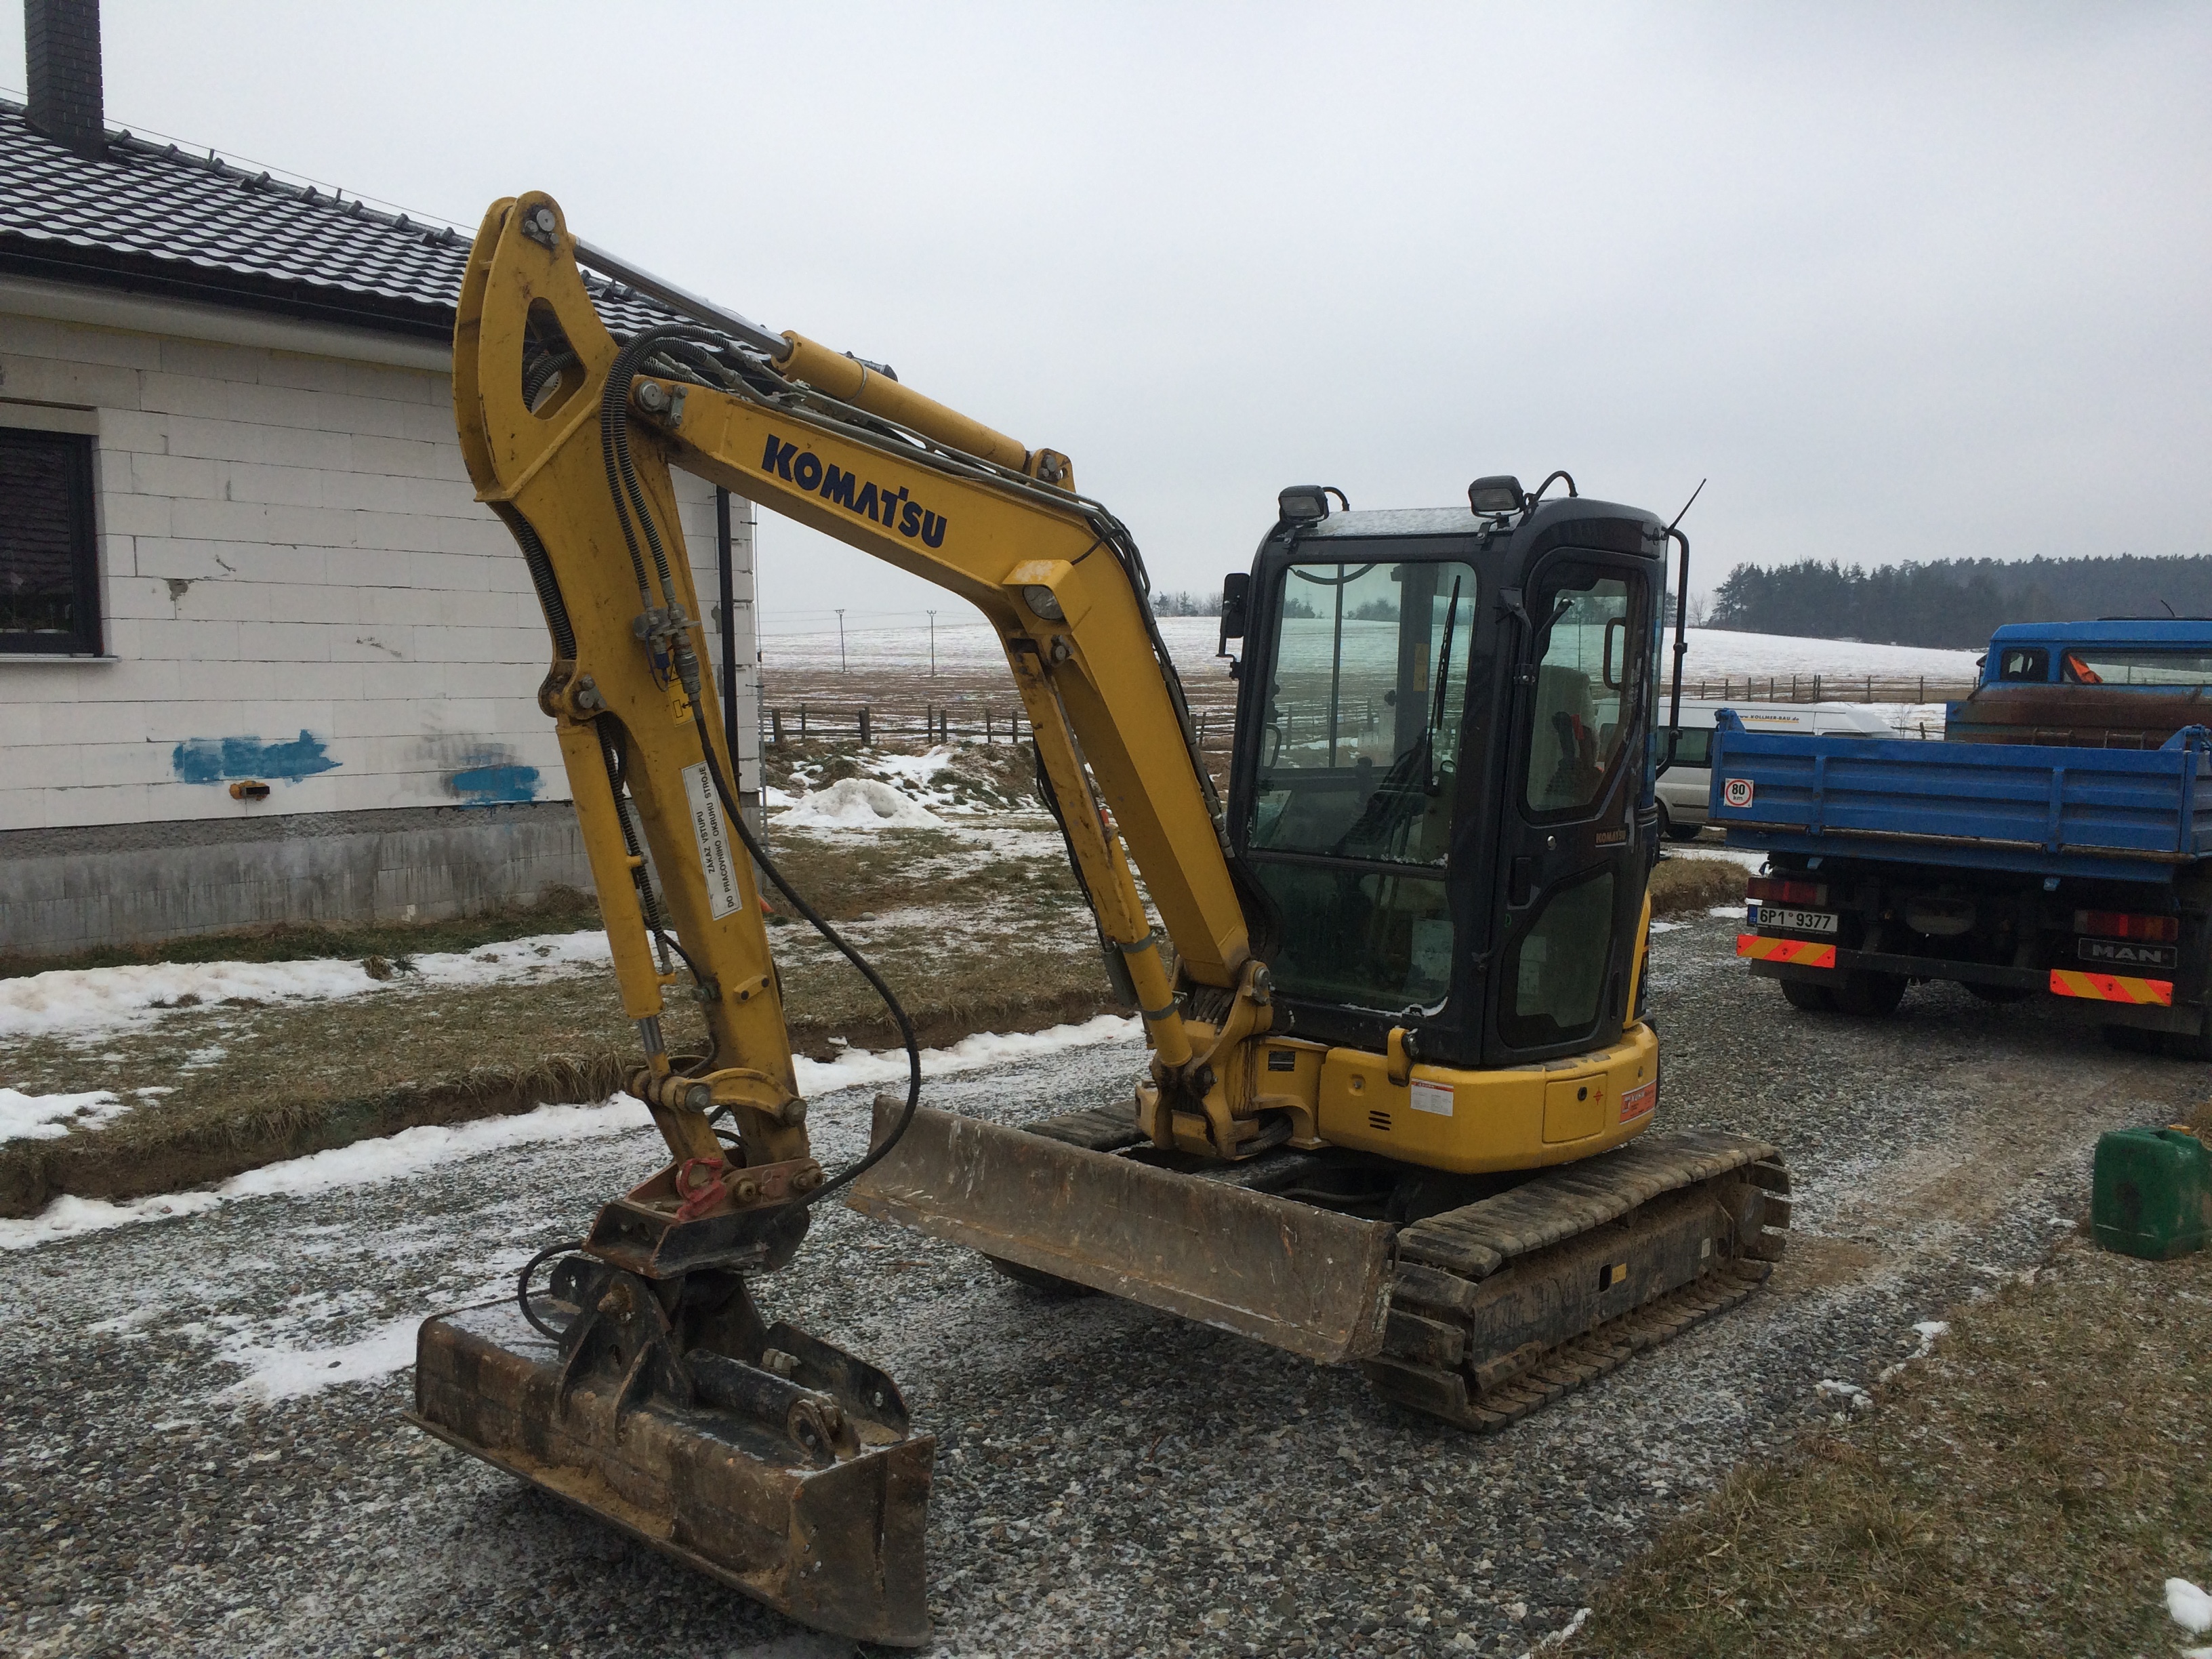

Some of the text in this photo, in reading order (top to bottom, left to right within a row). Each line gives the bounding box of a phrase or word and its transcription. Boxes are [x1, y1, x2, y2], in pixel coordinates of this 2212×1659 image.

[762, 434, 947, 548] KOMATSU
[699, 766, 712, 798] STROJE
[1732, 783, 1745, 795] 80
[696, 811, 709, 844] VSTUPU
[706, 802, 719, 836] OKRUHU
[1596, 828, 1626, 843] KOMATSU
[726, 895, 734, 907] DO
[1760, 909, 1784, 924] 6P1
[1796, 913, 1831, 929] 9377
[2092, 944, 2162, 963] MAN
